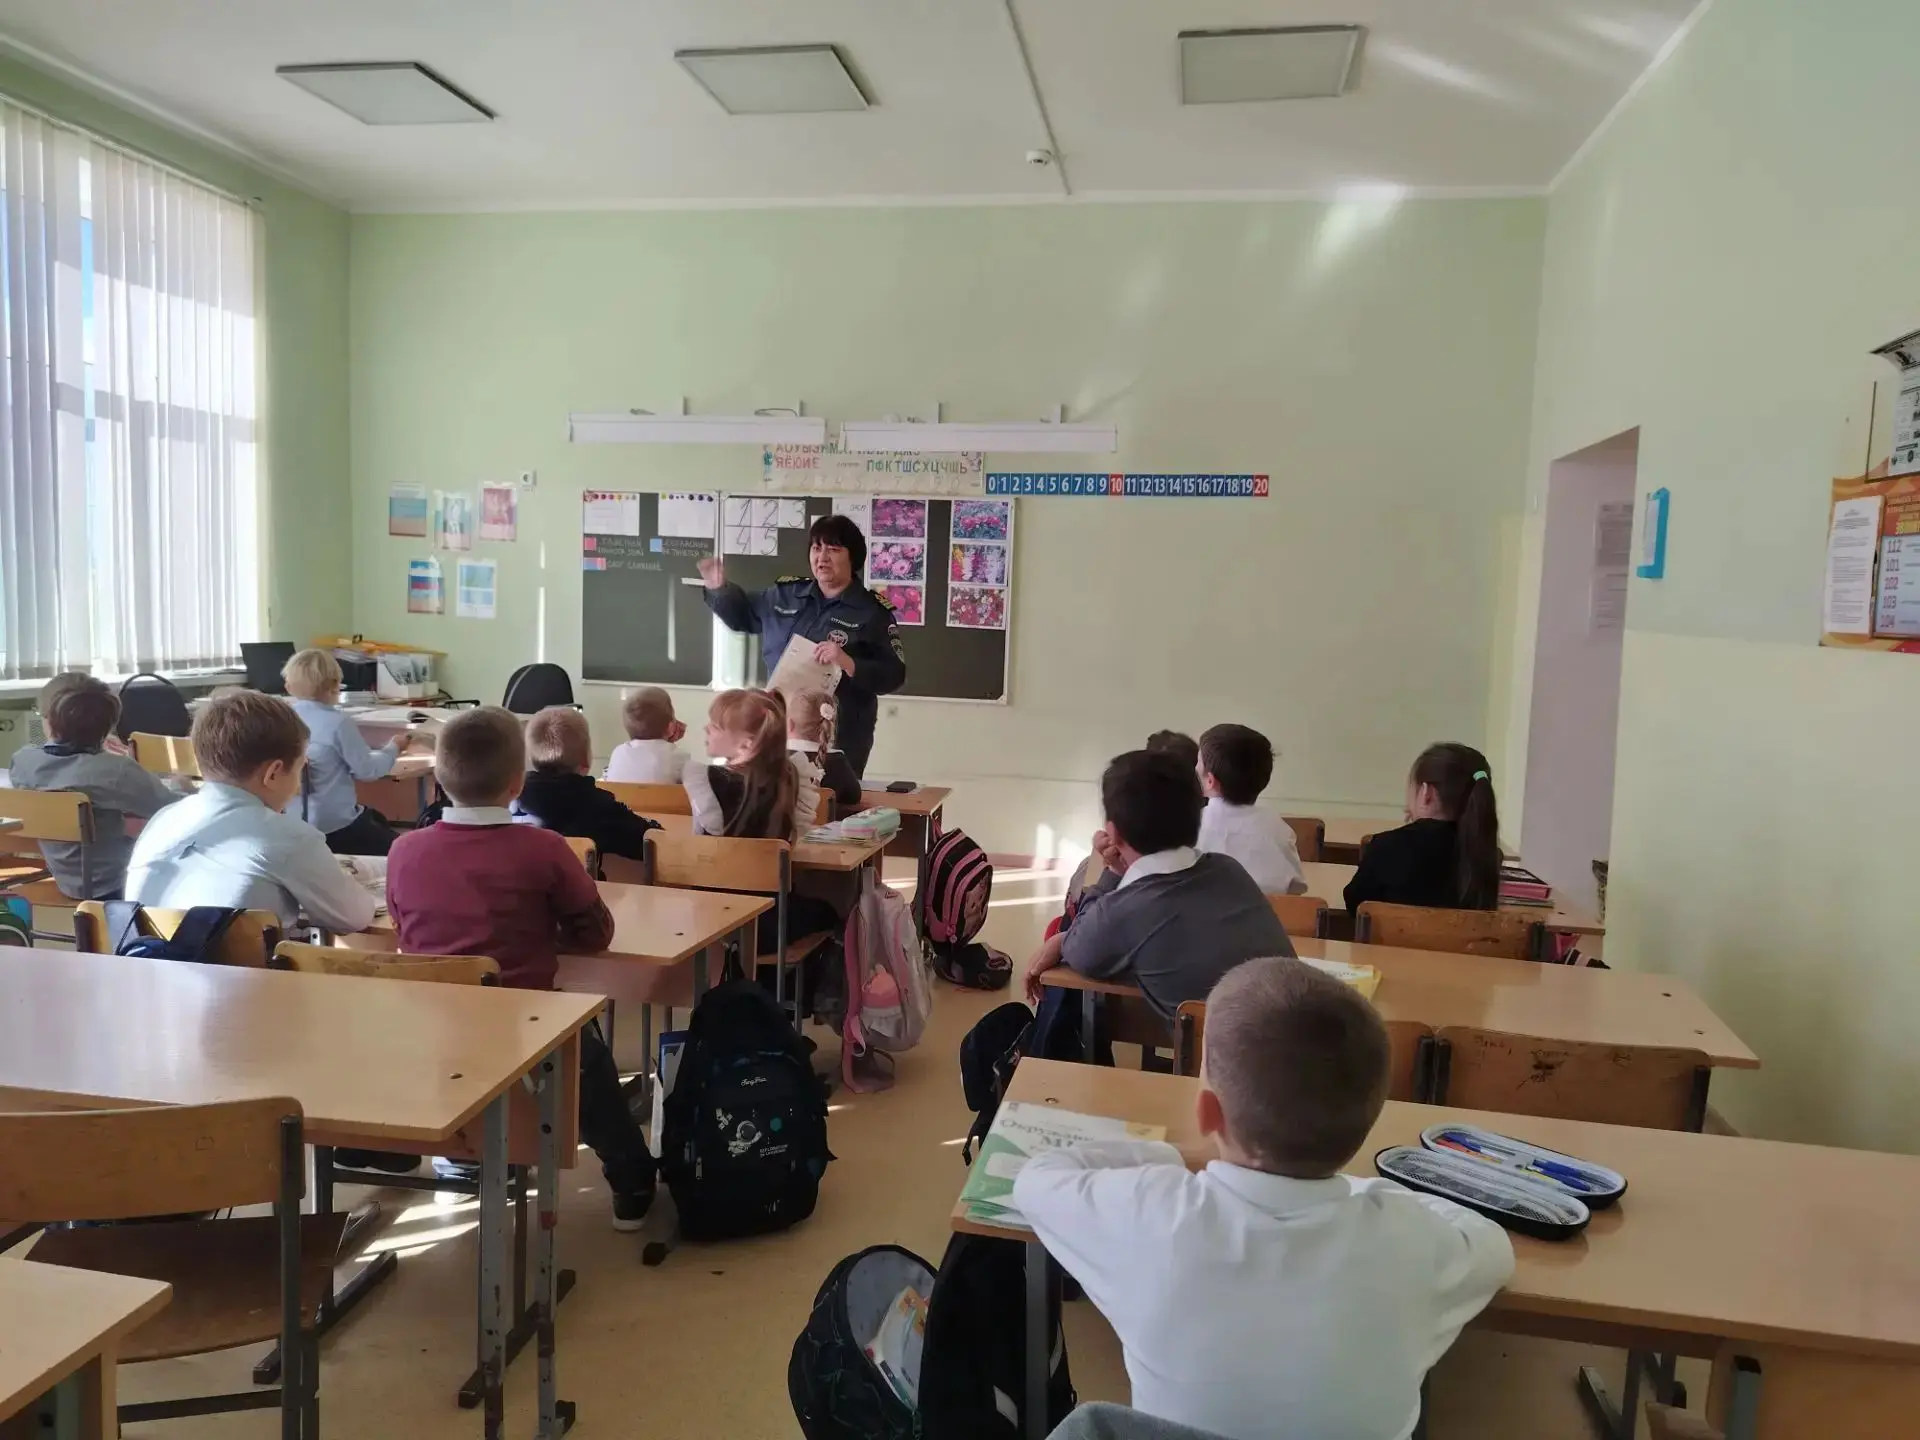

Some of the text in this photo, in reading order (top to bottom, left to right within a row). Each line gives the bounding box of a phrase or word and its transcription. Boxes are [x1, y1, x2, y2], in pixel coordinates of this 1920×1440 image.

[988, 476, 1268, 494] 0 1 2 3 4 5 6 7 8 9 10 11 12 13 14 15 16 17 18 19 20
[739, 499, 807, 528] 1 2 3
[760, 527, 778, 555] 5
